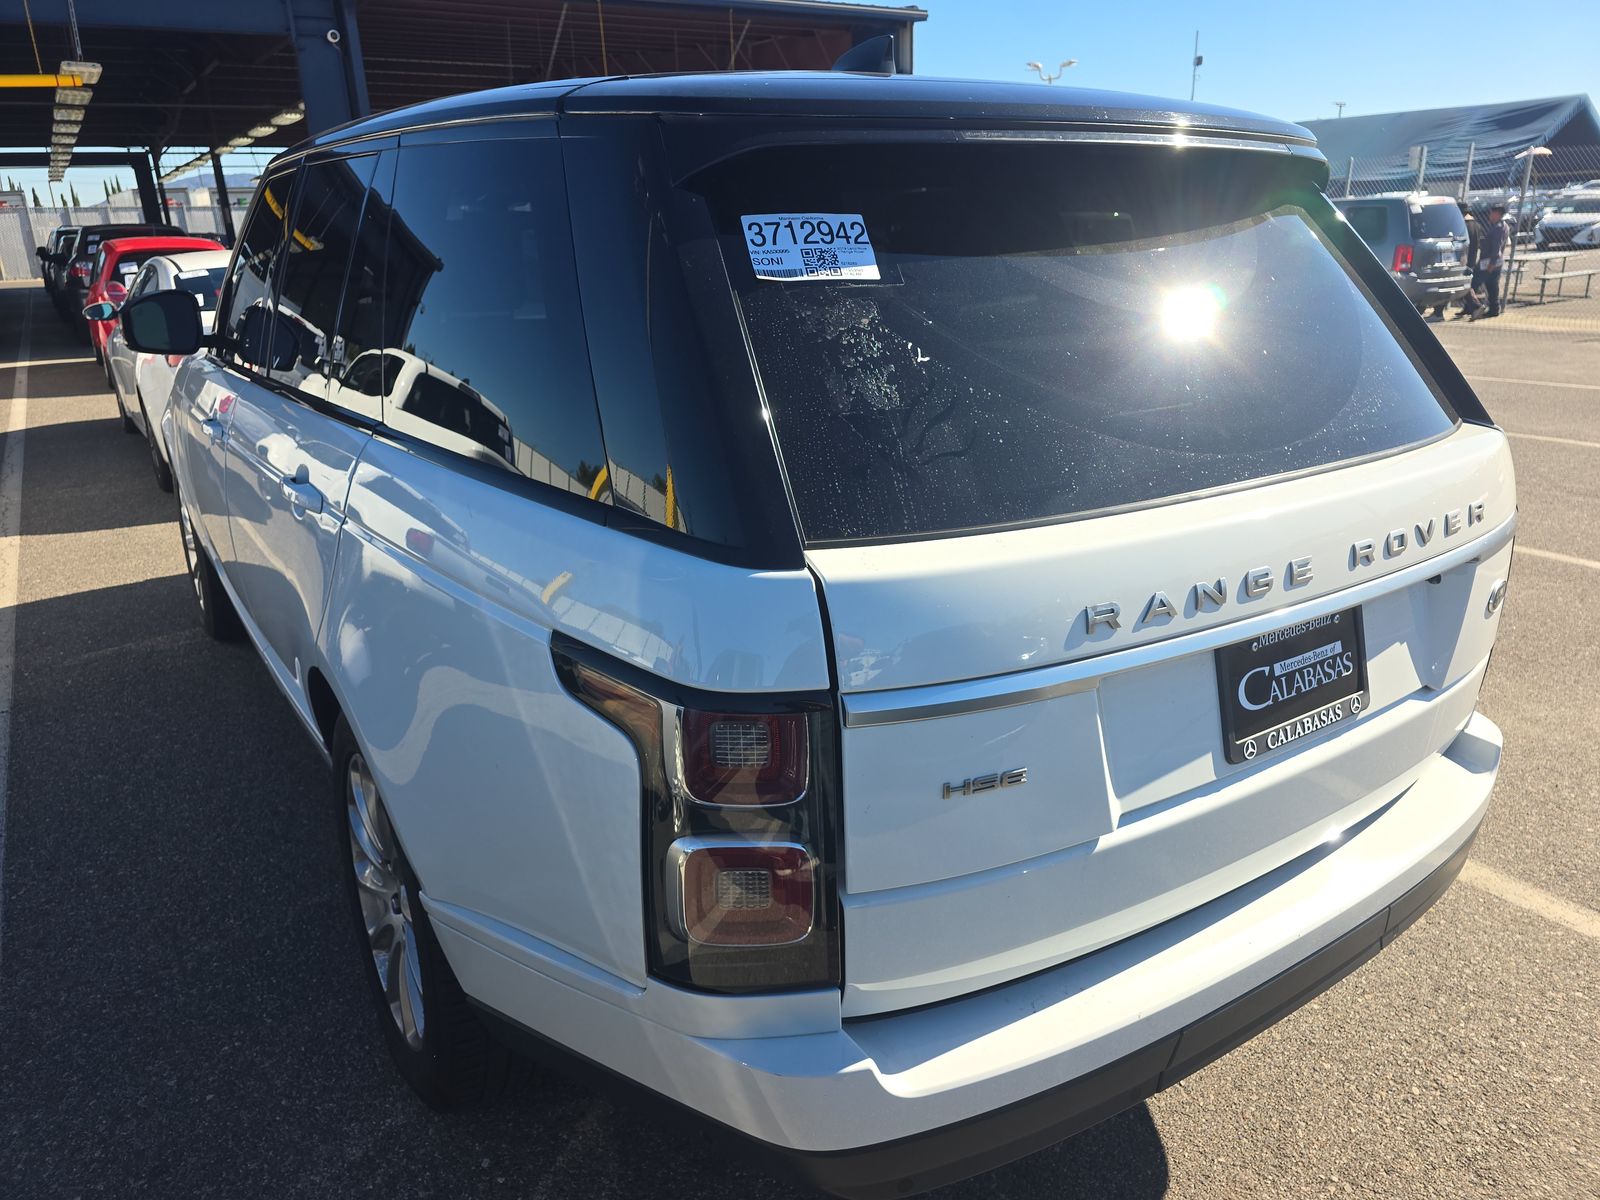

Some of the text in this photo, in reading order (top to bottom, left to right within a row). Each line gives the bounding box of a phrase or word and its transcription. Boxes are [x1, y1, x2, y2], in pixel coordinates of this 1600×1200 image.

[747, 221, 870, 247] 3712942
[752, 256, 784, 266] SONI
[1085, 499, 1485, 635] RANGE ROVER
[1279, 643, 1337, 673] Mercedes-Benz of
[1267, 703, 1343, 749] CALABASAS
[942, 766, 1028, 800] HSE
